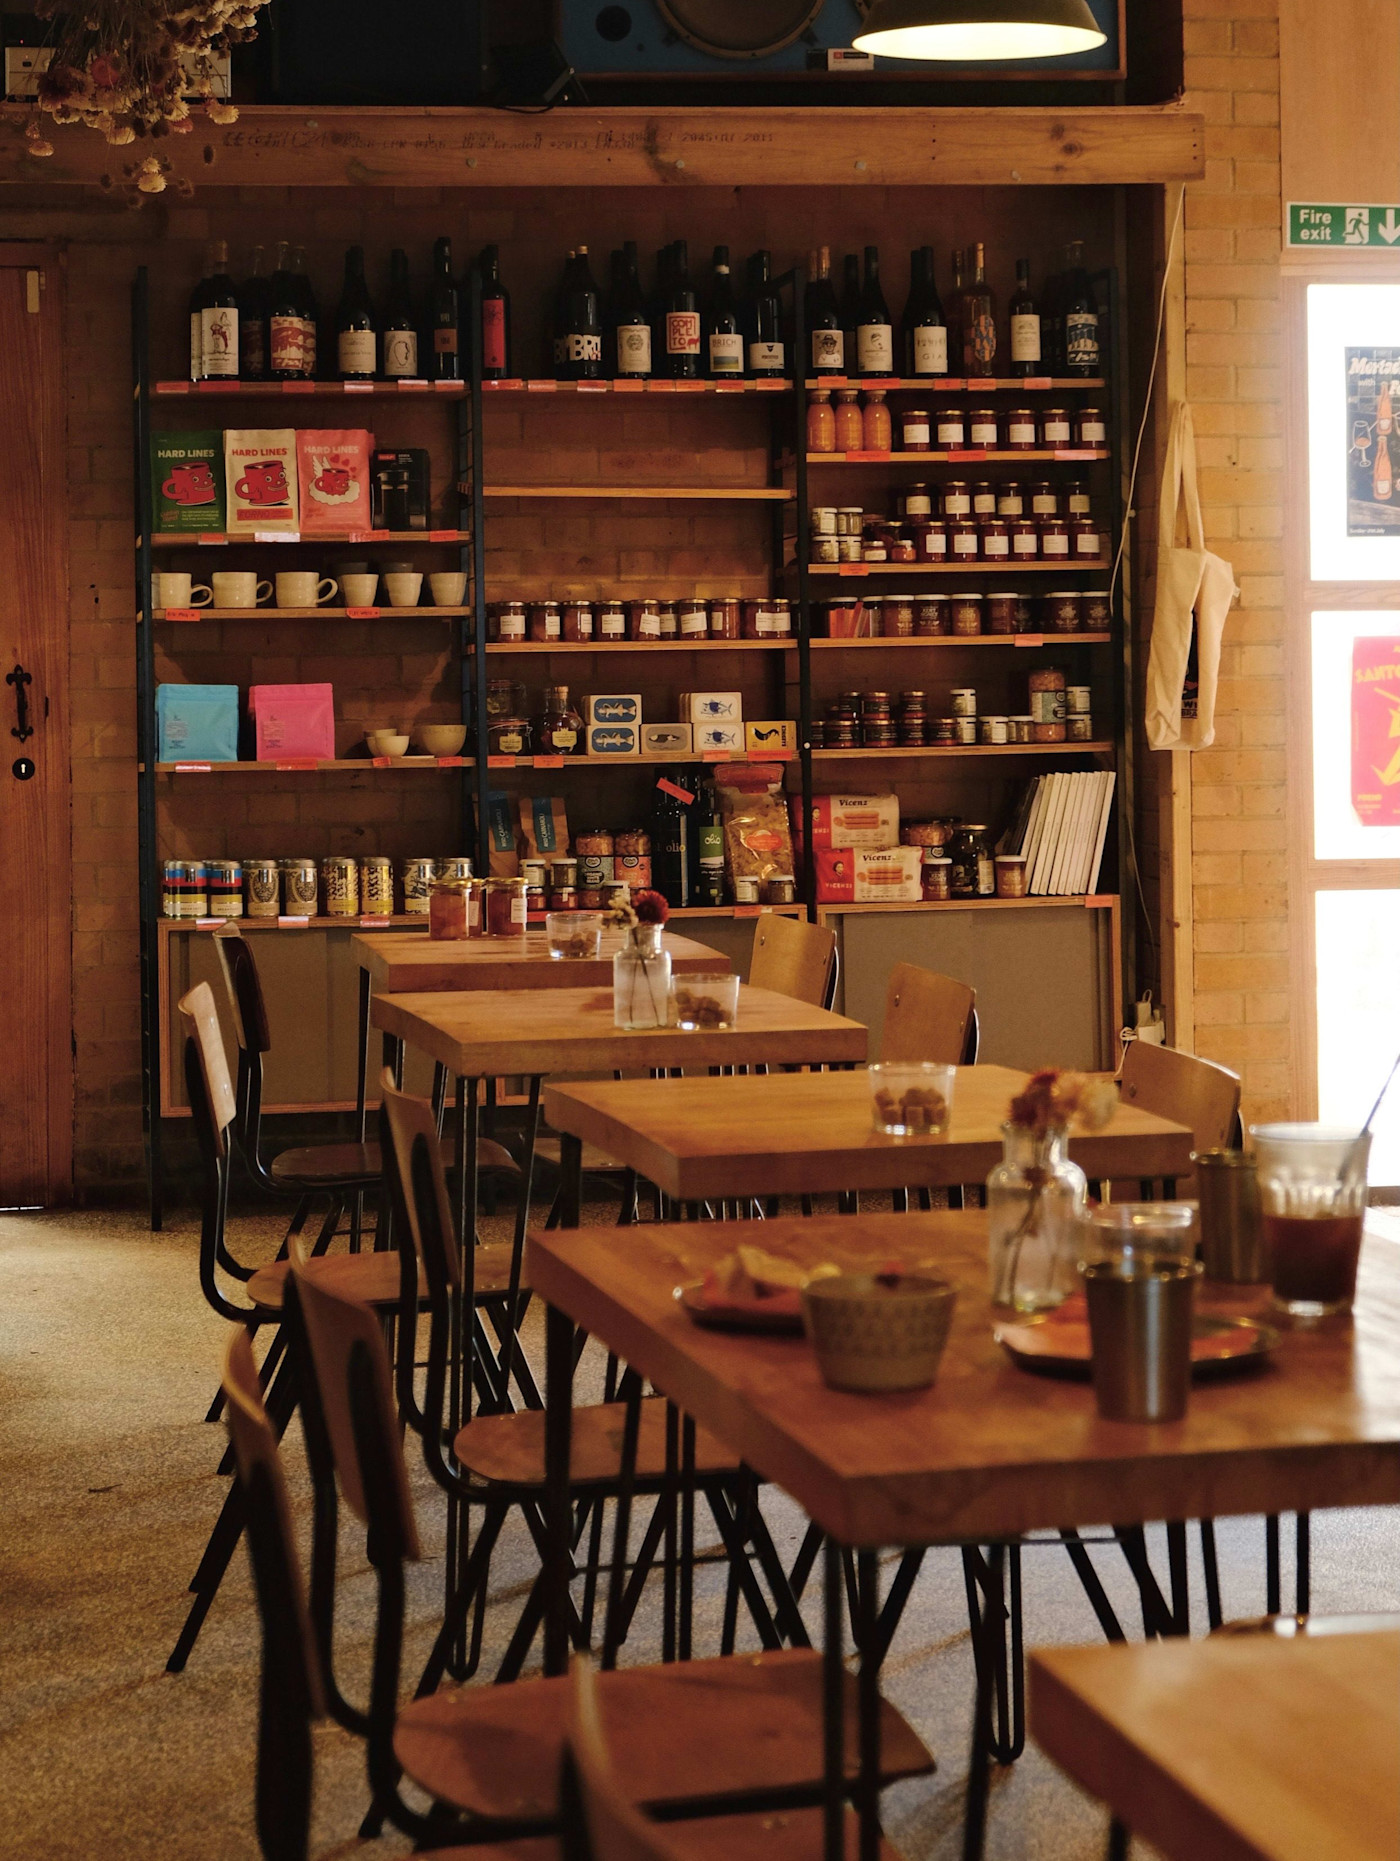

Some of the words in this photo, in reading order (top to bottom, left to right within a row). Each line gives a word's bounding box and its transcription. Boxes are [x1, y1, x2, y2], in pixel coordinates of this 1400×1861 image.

[1298, 208, 1333, 225] Fire
[1299, 225, 1332, 241] exit
[712, 338, 737, 346] BRICH
[158, 449, 186, 459] HARD
[187, 449, 215, 458] LINES
[232, 448, 258, 457] HARD
[260, 447, 288, 456] LINES
[304, 445, 331, 455] HARD
[332, 445, 359, 454] LINES
[704, 833, 721, 845] olio
[665, 842, 686, 853] olio
